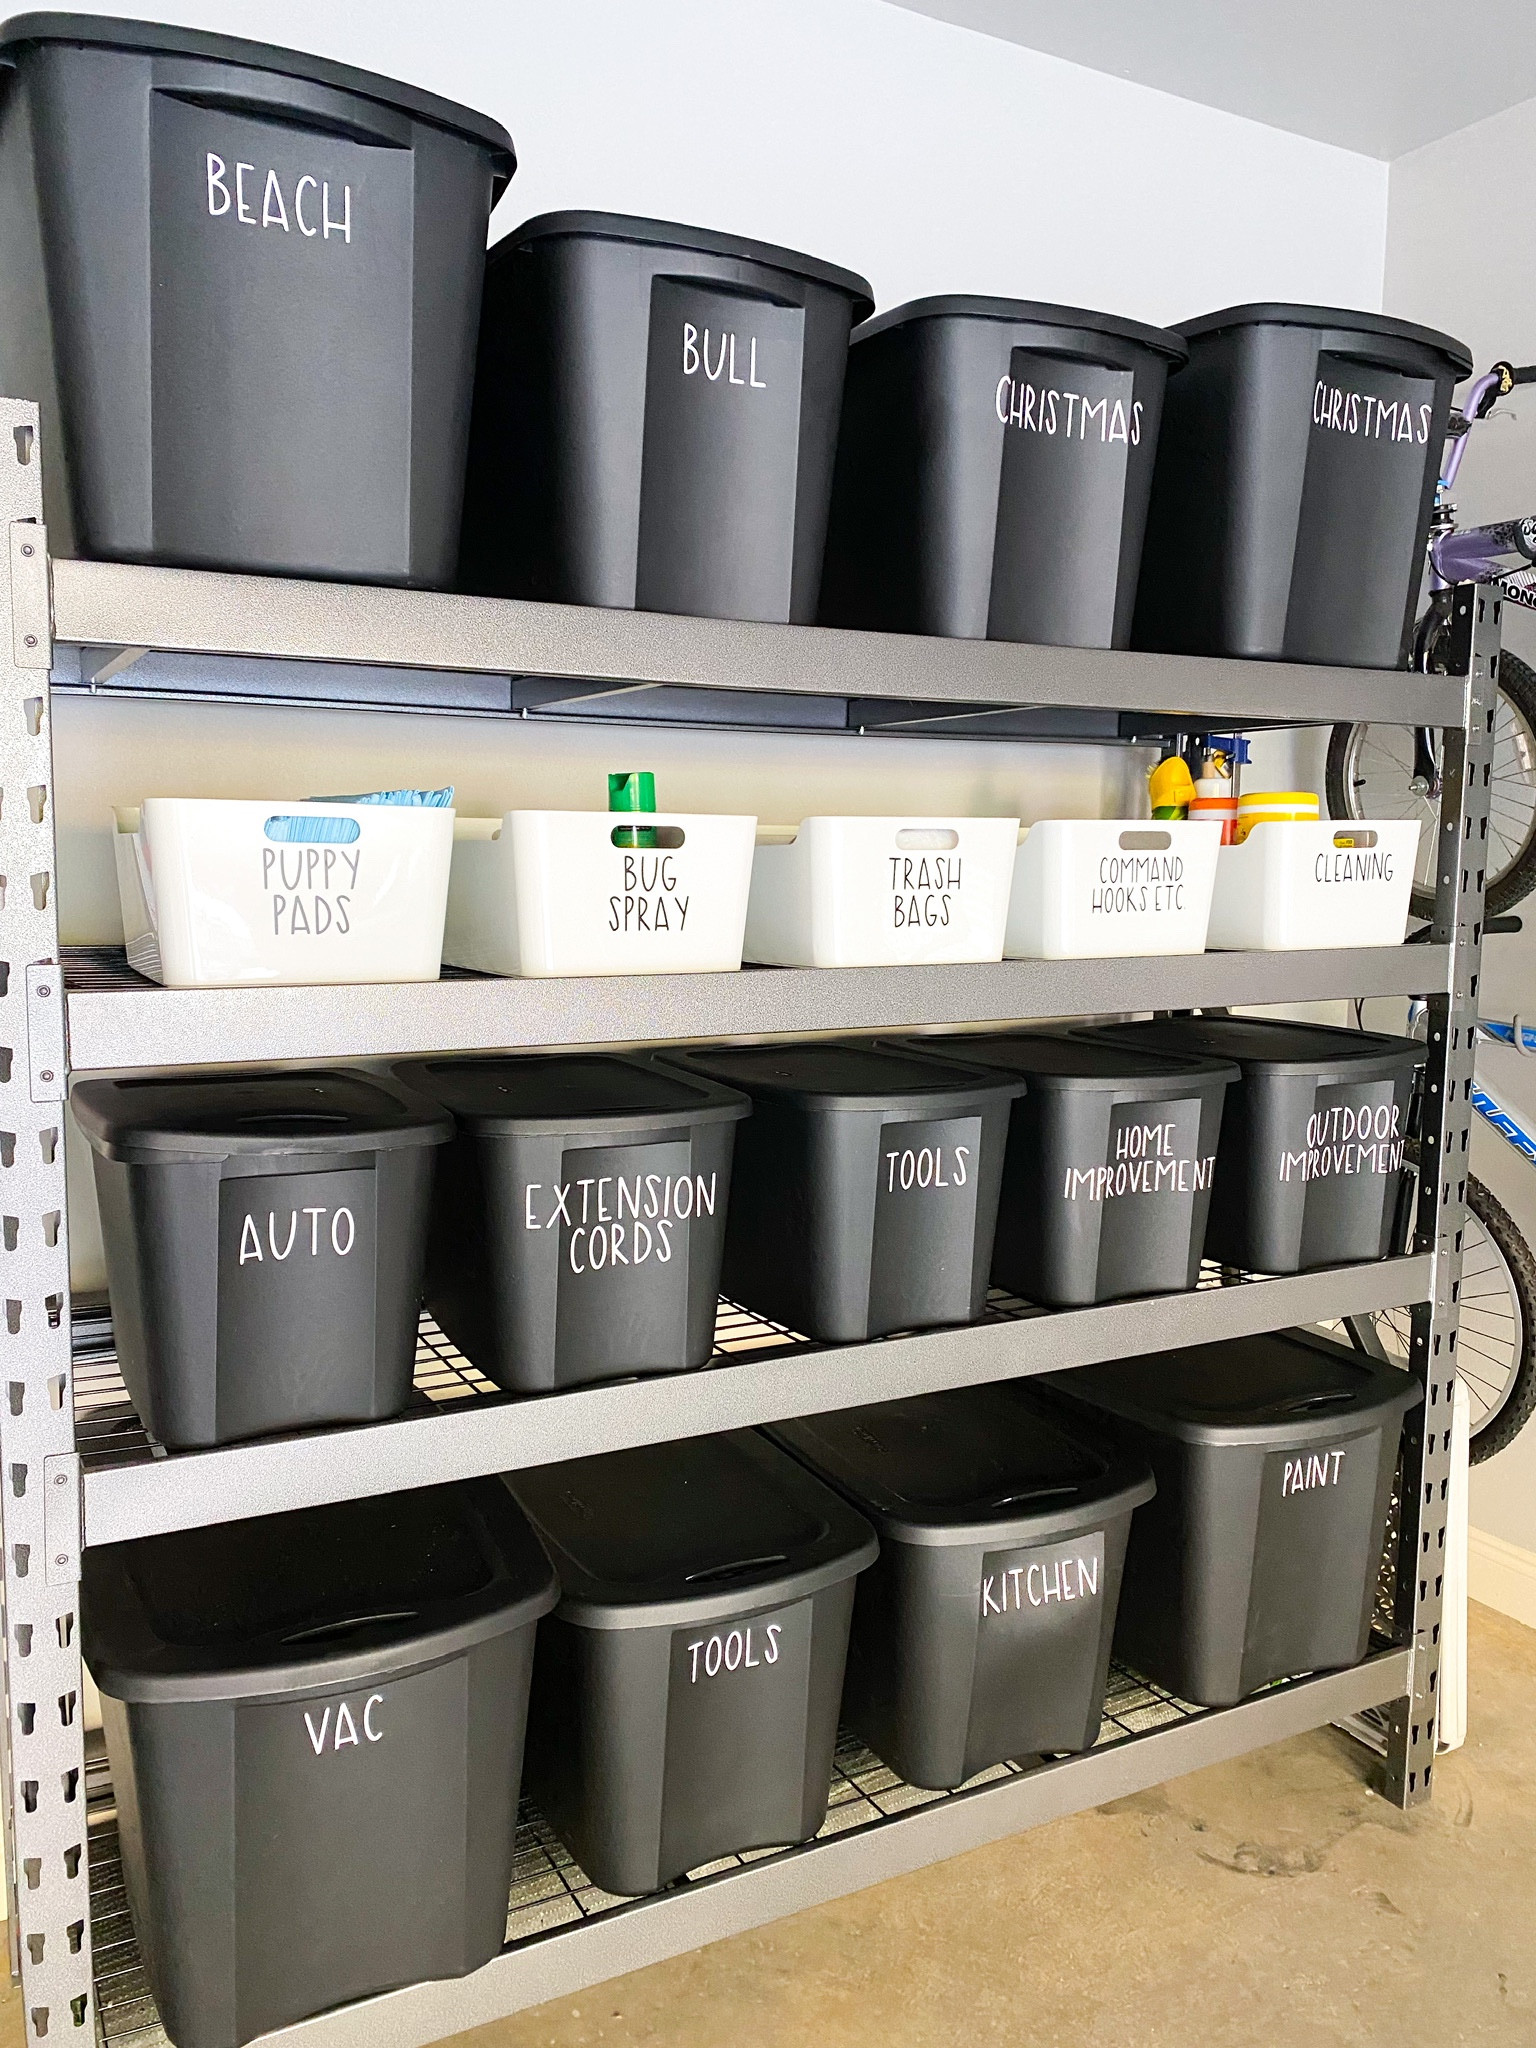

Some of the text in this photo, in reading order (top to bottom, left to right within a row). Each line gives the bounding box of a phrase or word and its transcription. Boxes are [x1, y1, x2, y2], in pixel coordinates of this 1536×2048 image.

[206, 152, 351, 244] BEACH
[683, 322, 767, 389] BULL
[995, 375, 1144, 446] CHRISTMAS
[1313, 380, 1433, 445] CHRISTMAS
[263, 848, 360, 890] PUPPY
[624, 855, 677, 892] BUG
[889, 857, 961, 890] TRASH
[1100, 856, 1184, 883] COMMAND
[1314, 852, 1394, 882] CLEANING
[274, 894, 351, 936] PADS
[609, 895, 690, 932] SPRAY
[894, 894, 952, 928] BAGS
[1092, 886, 1148, 913] HOOKS
[1116, 1124, 1176, 1160] HOME
[1306, 1104, 1400, 1148] OUTDOOR
[887, 1147, 970, 1193] TOOLS
[1064, 1156, 1216, 1200] IMPROVEMENT
[1280, 1140, 1405, 1181] IMPROVEMENT
[525, 1172, 717, 1229] EXTENSION
[239, 1207, 355, 1266] AUTO
[570, 1219, 674, 1274] CORDS
[1282, 1450, 1346, 1498] PAINT
[981, 1556, 1099, 1617] KITCHEN
[688, 1624, 782, 1683] TOOLS
[304, 1694, 384, 1755] VAC
